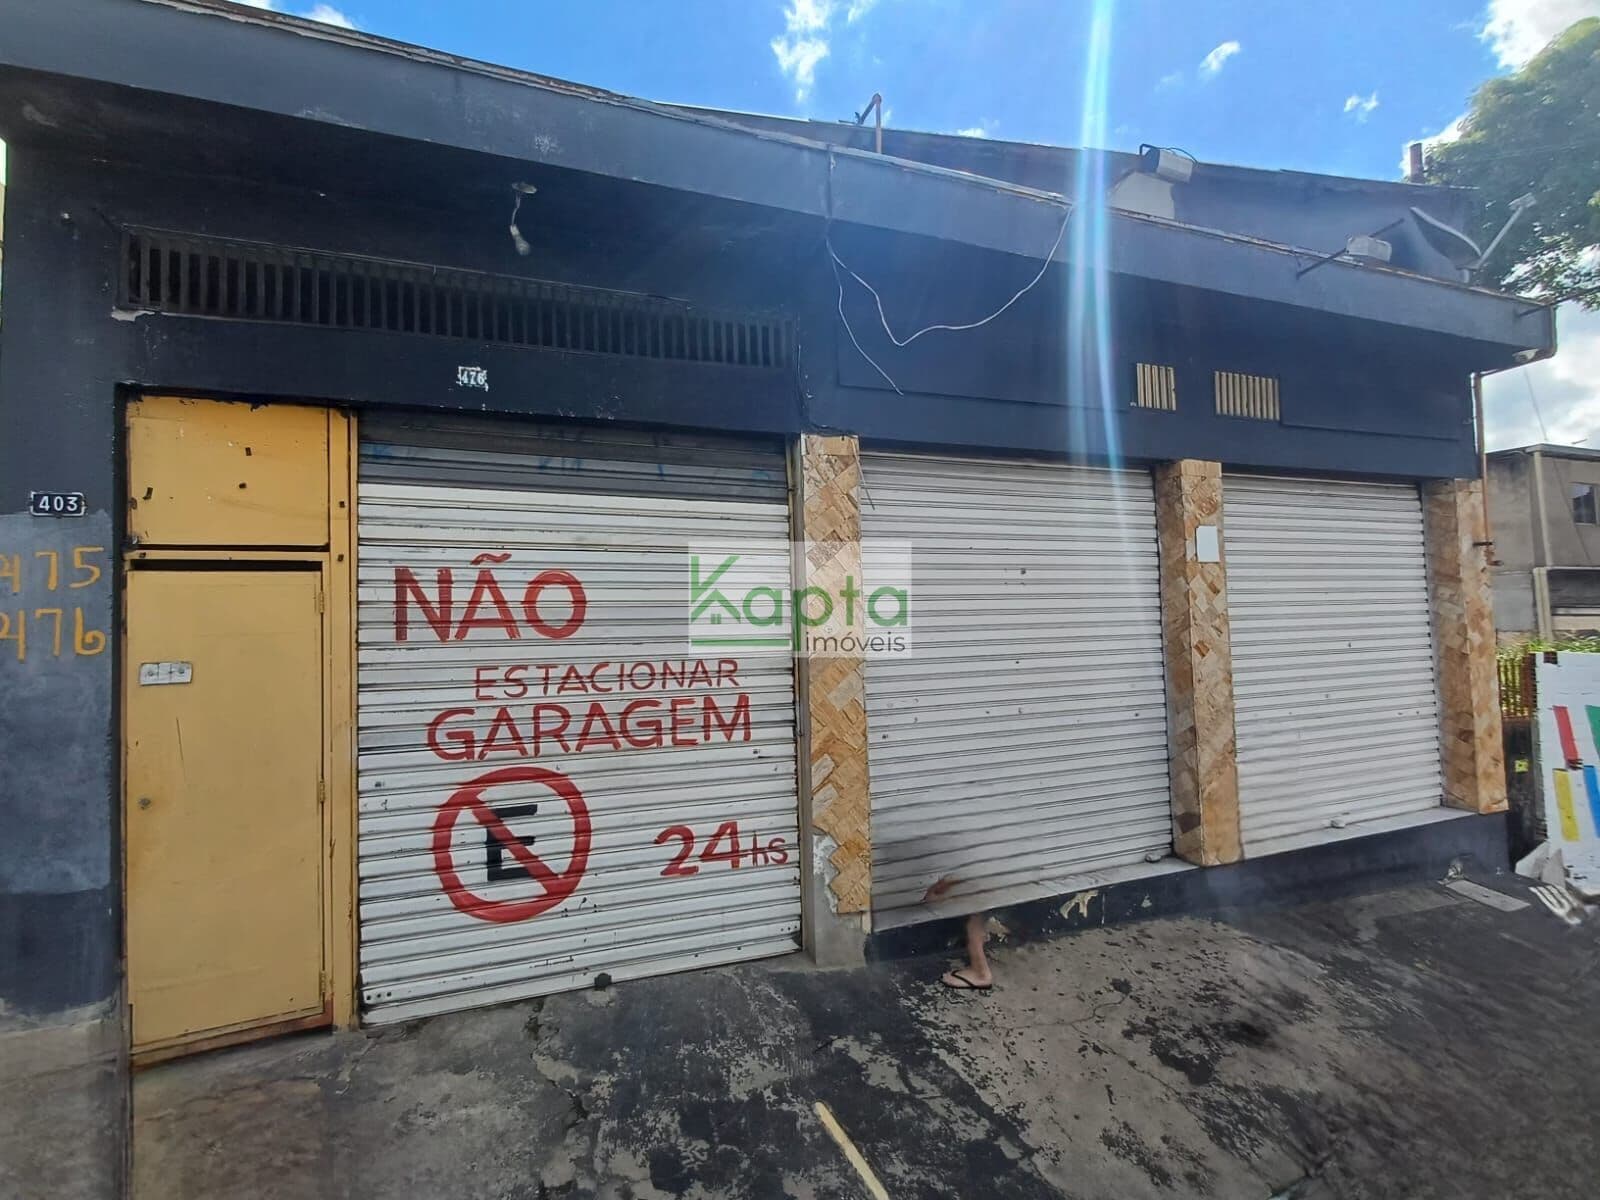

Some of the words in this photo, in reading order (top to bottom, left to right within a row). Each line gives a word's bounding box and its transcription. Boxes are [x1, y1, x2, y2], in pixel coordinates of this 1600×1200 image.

[461, 370, 486, 385] 476
[38, 496, 79, 512] 403
[393, 552, 587, 643] NÃO
[474, 658, 740, 700] ESTACIONAR
[426, 692, 752, 761] GARAGEM
